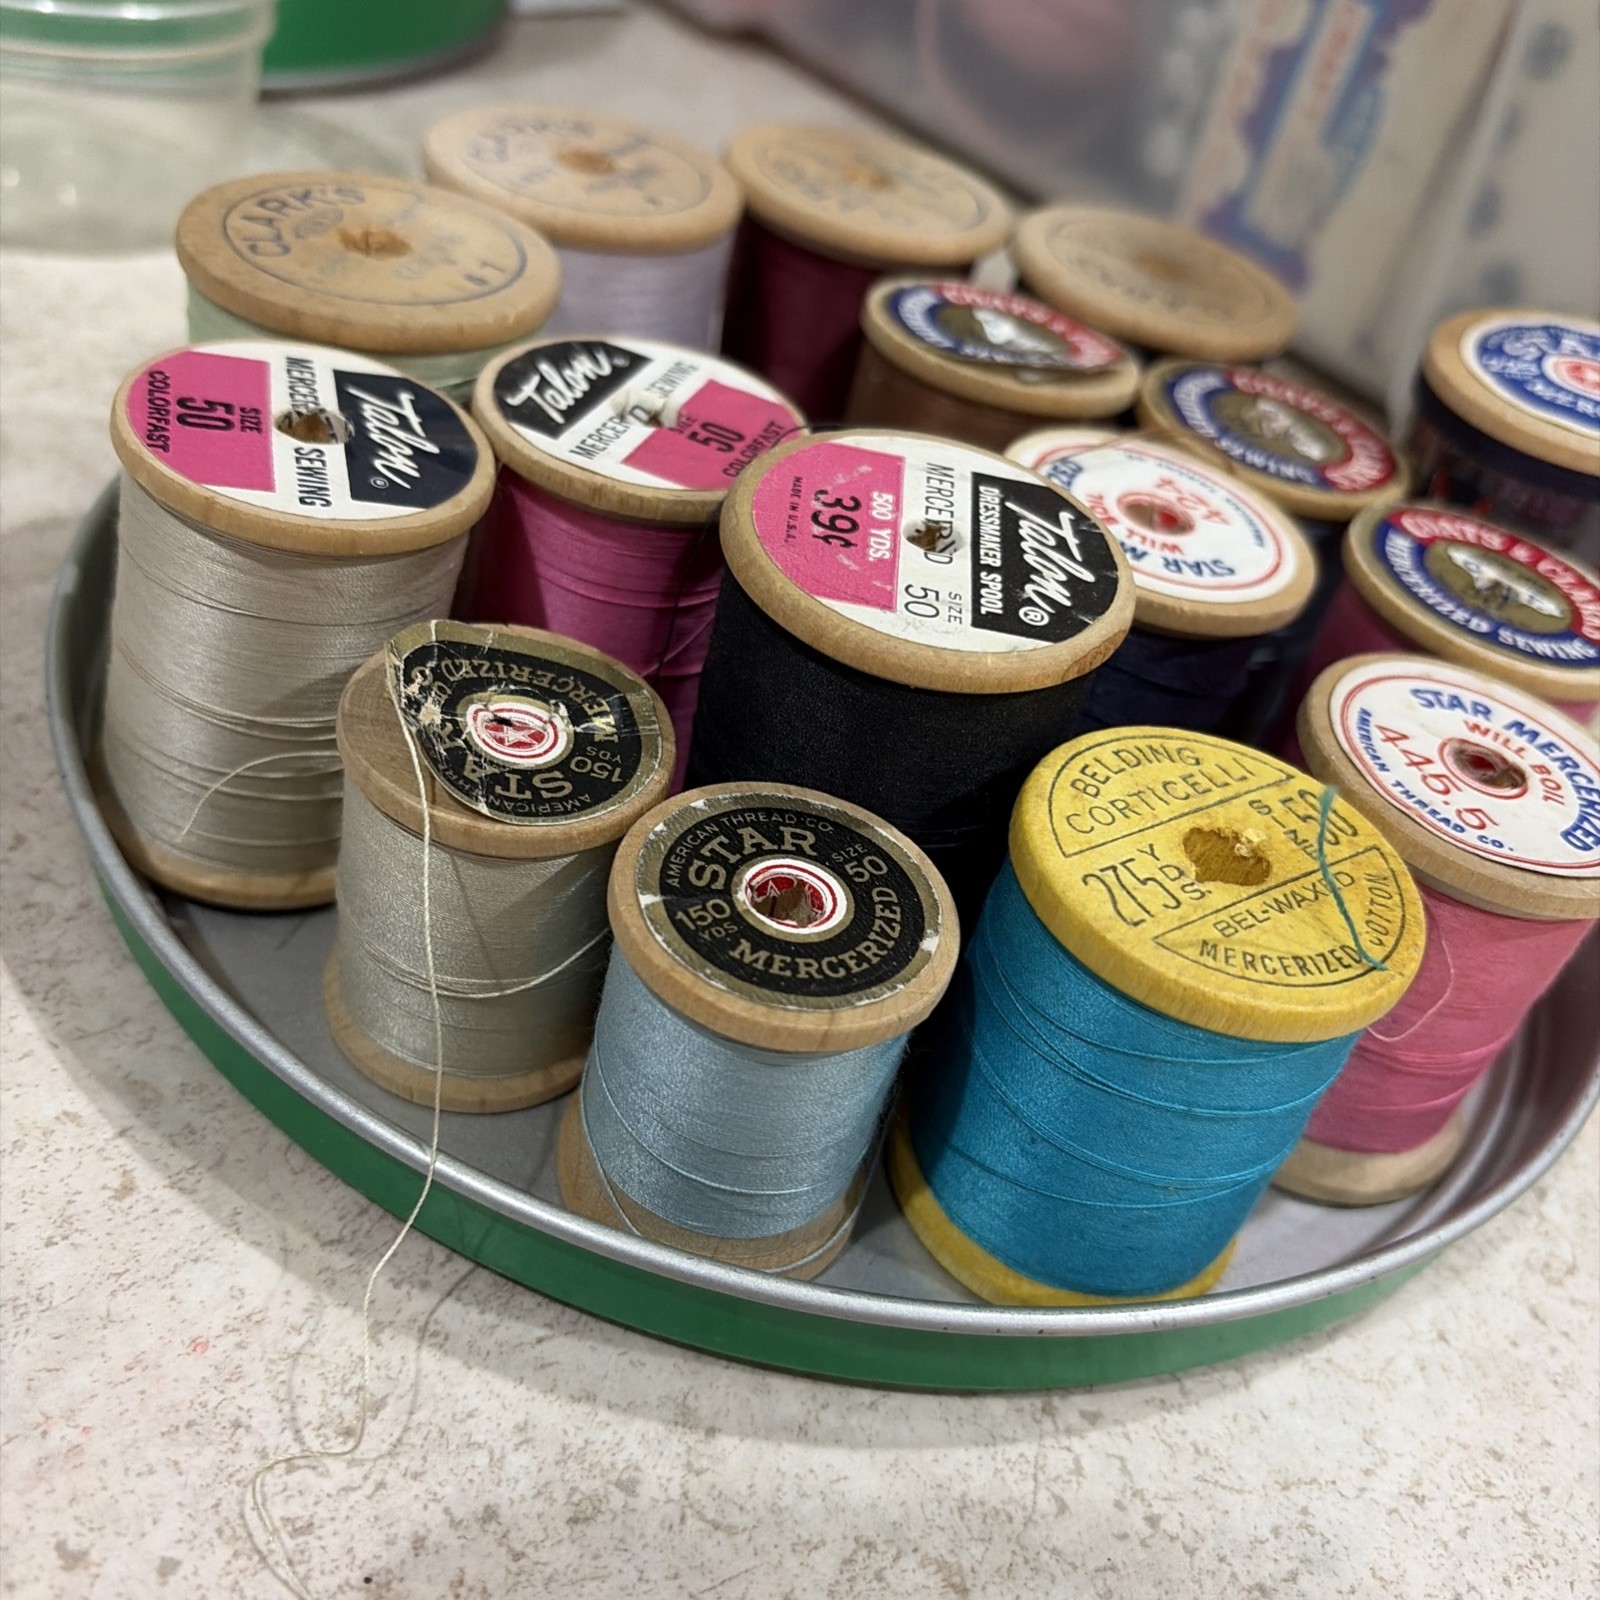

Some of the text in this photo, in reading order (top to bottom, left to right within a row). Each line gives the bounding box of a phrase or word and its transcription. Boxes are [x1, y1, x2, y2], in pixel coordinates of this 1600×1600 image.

[147, 371, 171, 453] COLORFAST
[176, 397, 235, 432] 50
[240, 407, 263, 434] SIZE
[688, 422, 745, 453] 50
[294, 447, 332, 508] SEWING
[791, 476, 803, 499] MADE
[789, 502, 798, 512] IN
[811, 489, 862, 549] 39¢
[868, 491, 894, 562] 500 YDS.
[1125, 528, 1184, 555] WILL
[979, 486, 1003, 615] DRESSMAKER SPOOL
[1163, 556, 1236, 578] STAR
[904, 584, 940, 619] 50
[948, 592, 963, 625] SIZE
[441, 658, 619, 744] MERCERIZED
[1410, 688, 1492, 722] STAR
[570, 756, 623, 784] 150
[586, 745, 622, 763] YDS
[1070, 744, 1200, 798] BELDING
[1356, 707, 1391, 773] AMERICAN
[1391, 779, 1466, 834] THREAD
[1464, 719, 1566, 806] WILL BOIL
[1066, 758, 1255, 834] CORTICELLI
[666, 823, 719, 887] AMERICAN
[720, 812, 797, 827] THREAD
[688, 826, 817, 890] STAR
[831, 844, 868, 863] SIZE
[844, 855, 888, 883] 50
[1081, 857, 1182, 927] 275
[1363, 873, 1393, 946] COTTON
[675, 898, 731, 930] 150
[698, 921, 738, 941] YDS
[730, 887, 901, 980] MERCERIZED
[1199, 944, 1363, 977] MERCERIZED
